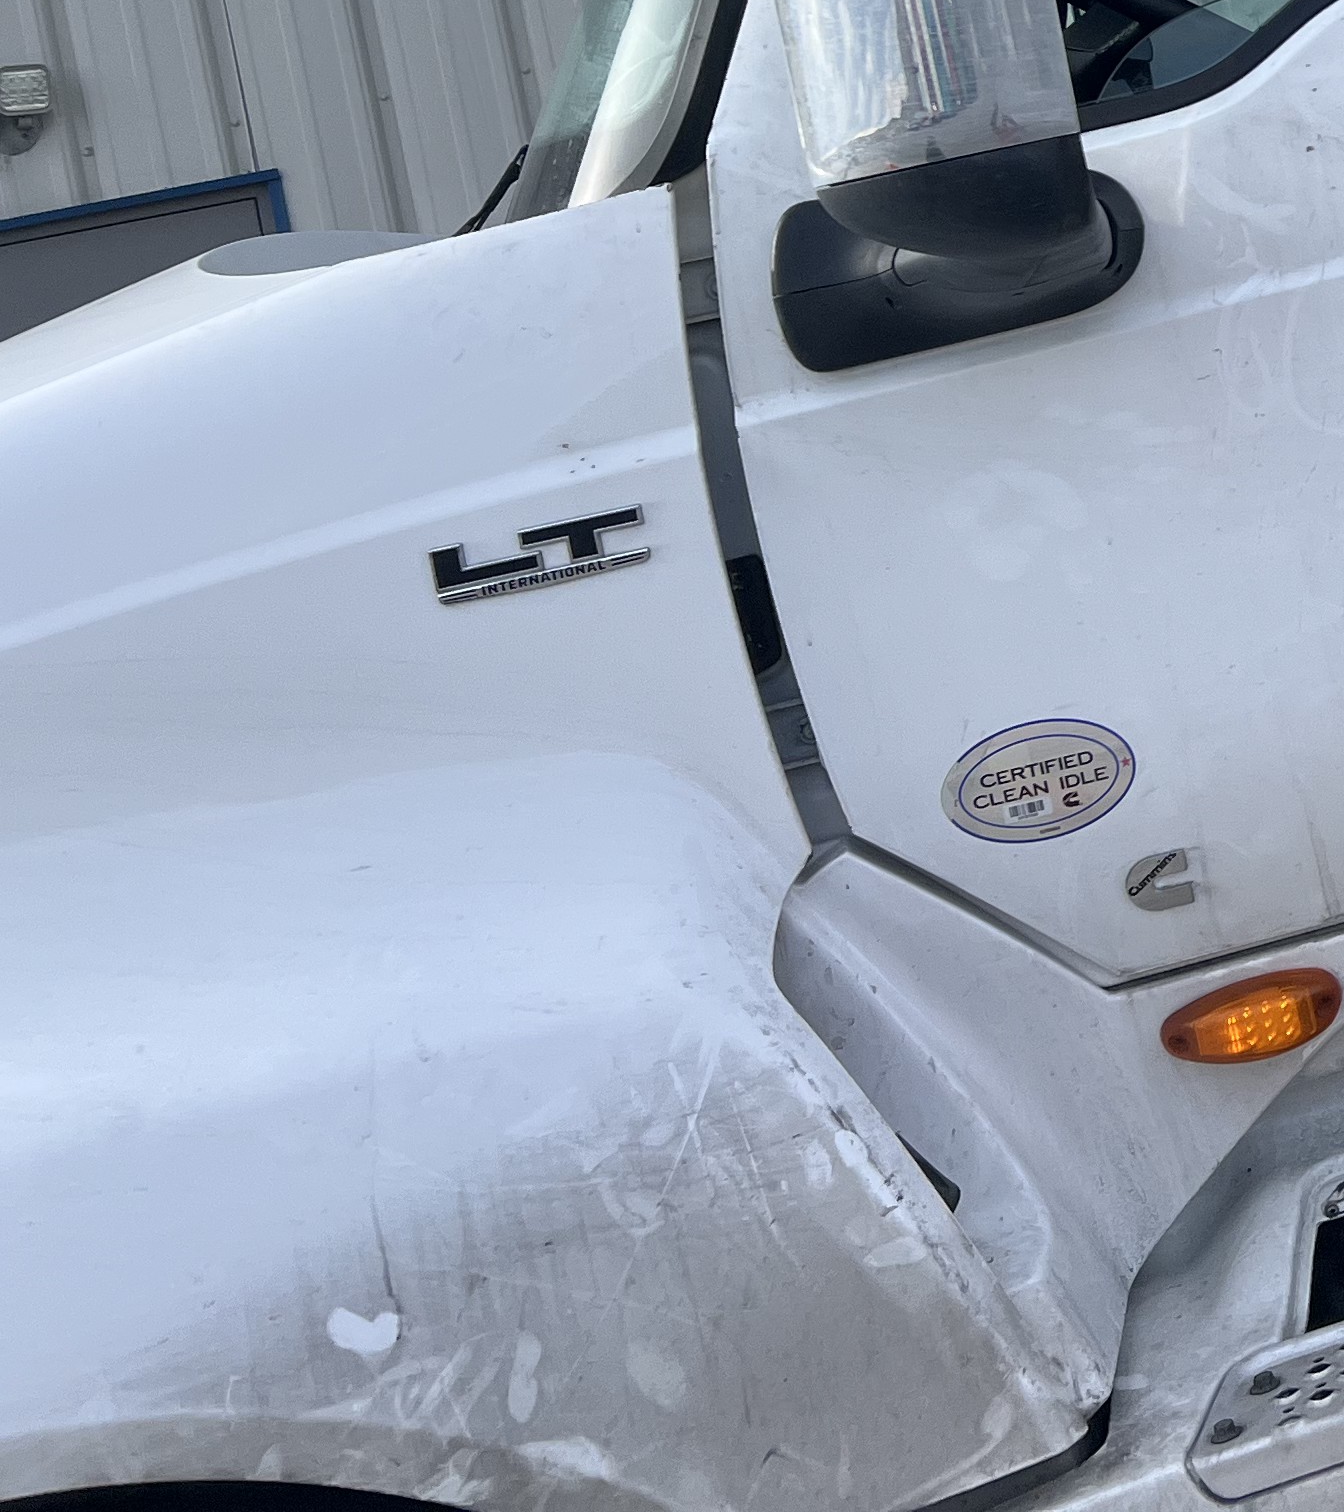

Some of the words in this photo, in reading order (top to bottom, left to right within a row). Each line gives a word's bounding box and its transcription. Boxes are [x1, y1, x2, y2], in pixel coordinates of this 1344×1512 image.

[427, 503, 645, 594] LT
[481, 560, 607, 597] INTERNATIONAL
[973, 780, 1050, 810] CLEAN
[1059, 766, 1110, 790] IDLE
[980, 751, 1093, 788] CERTIFIED
